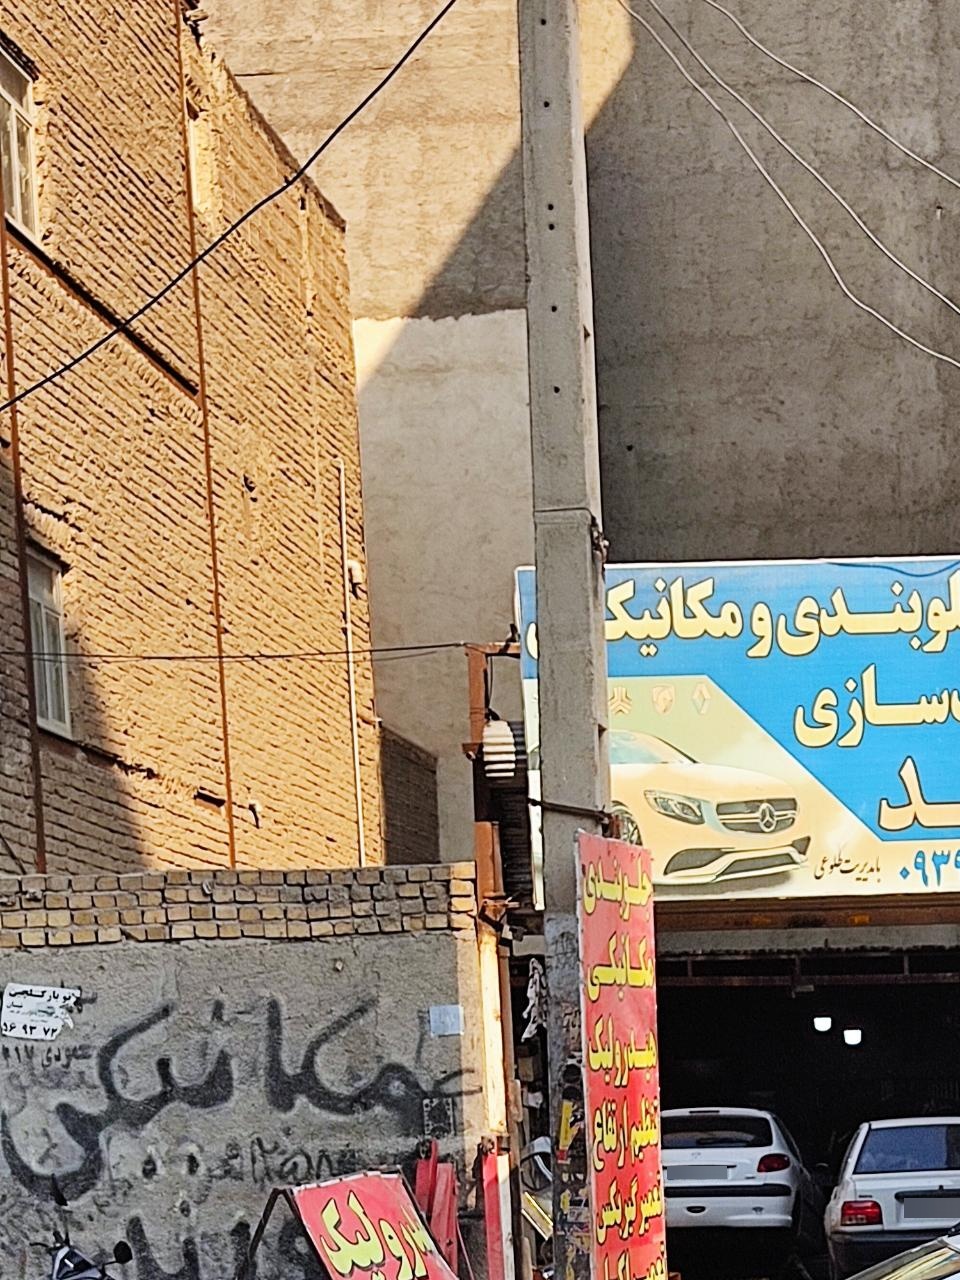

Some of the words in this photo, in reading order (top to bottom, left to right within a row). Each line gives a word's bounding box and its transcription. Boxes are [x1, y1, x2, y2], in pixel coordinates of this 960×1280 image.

[525, 576, 744, 660] مکانیک
[746, 601, 774, 659] و
[793, 662, 951, 748] سازی
[584, 853, 653, 921] جلوبندی
[586, 930, 655, 1003] مکانیکی
[589, 1014, 657, 1087] هیدرولیک
[592, 1094, 629, 1172] ارتفاع
[630, 1094, 660, 1167] تنظیم
[595, 1175, 639, 1244] گیربکس
[639, 1171, 664, 1237] تعمیر
